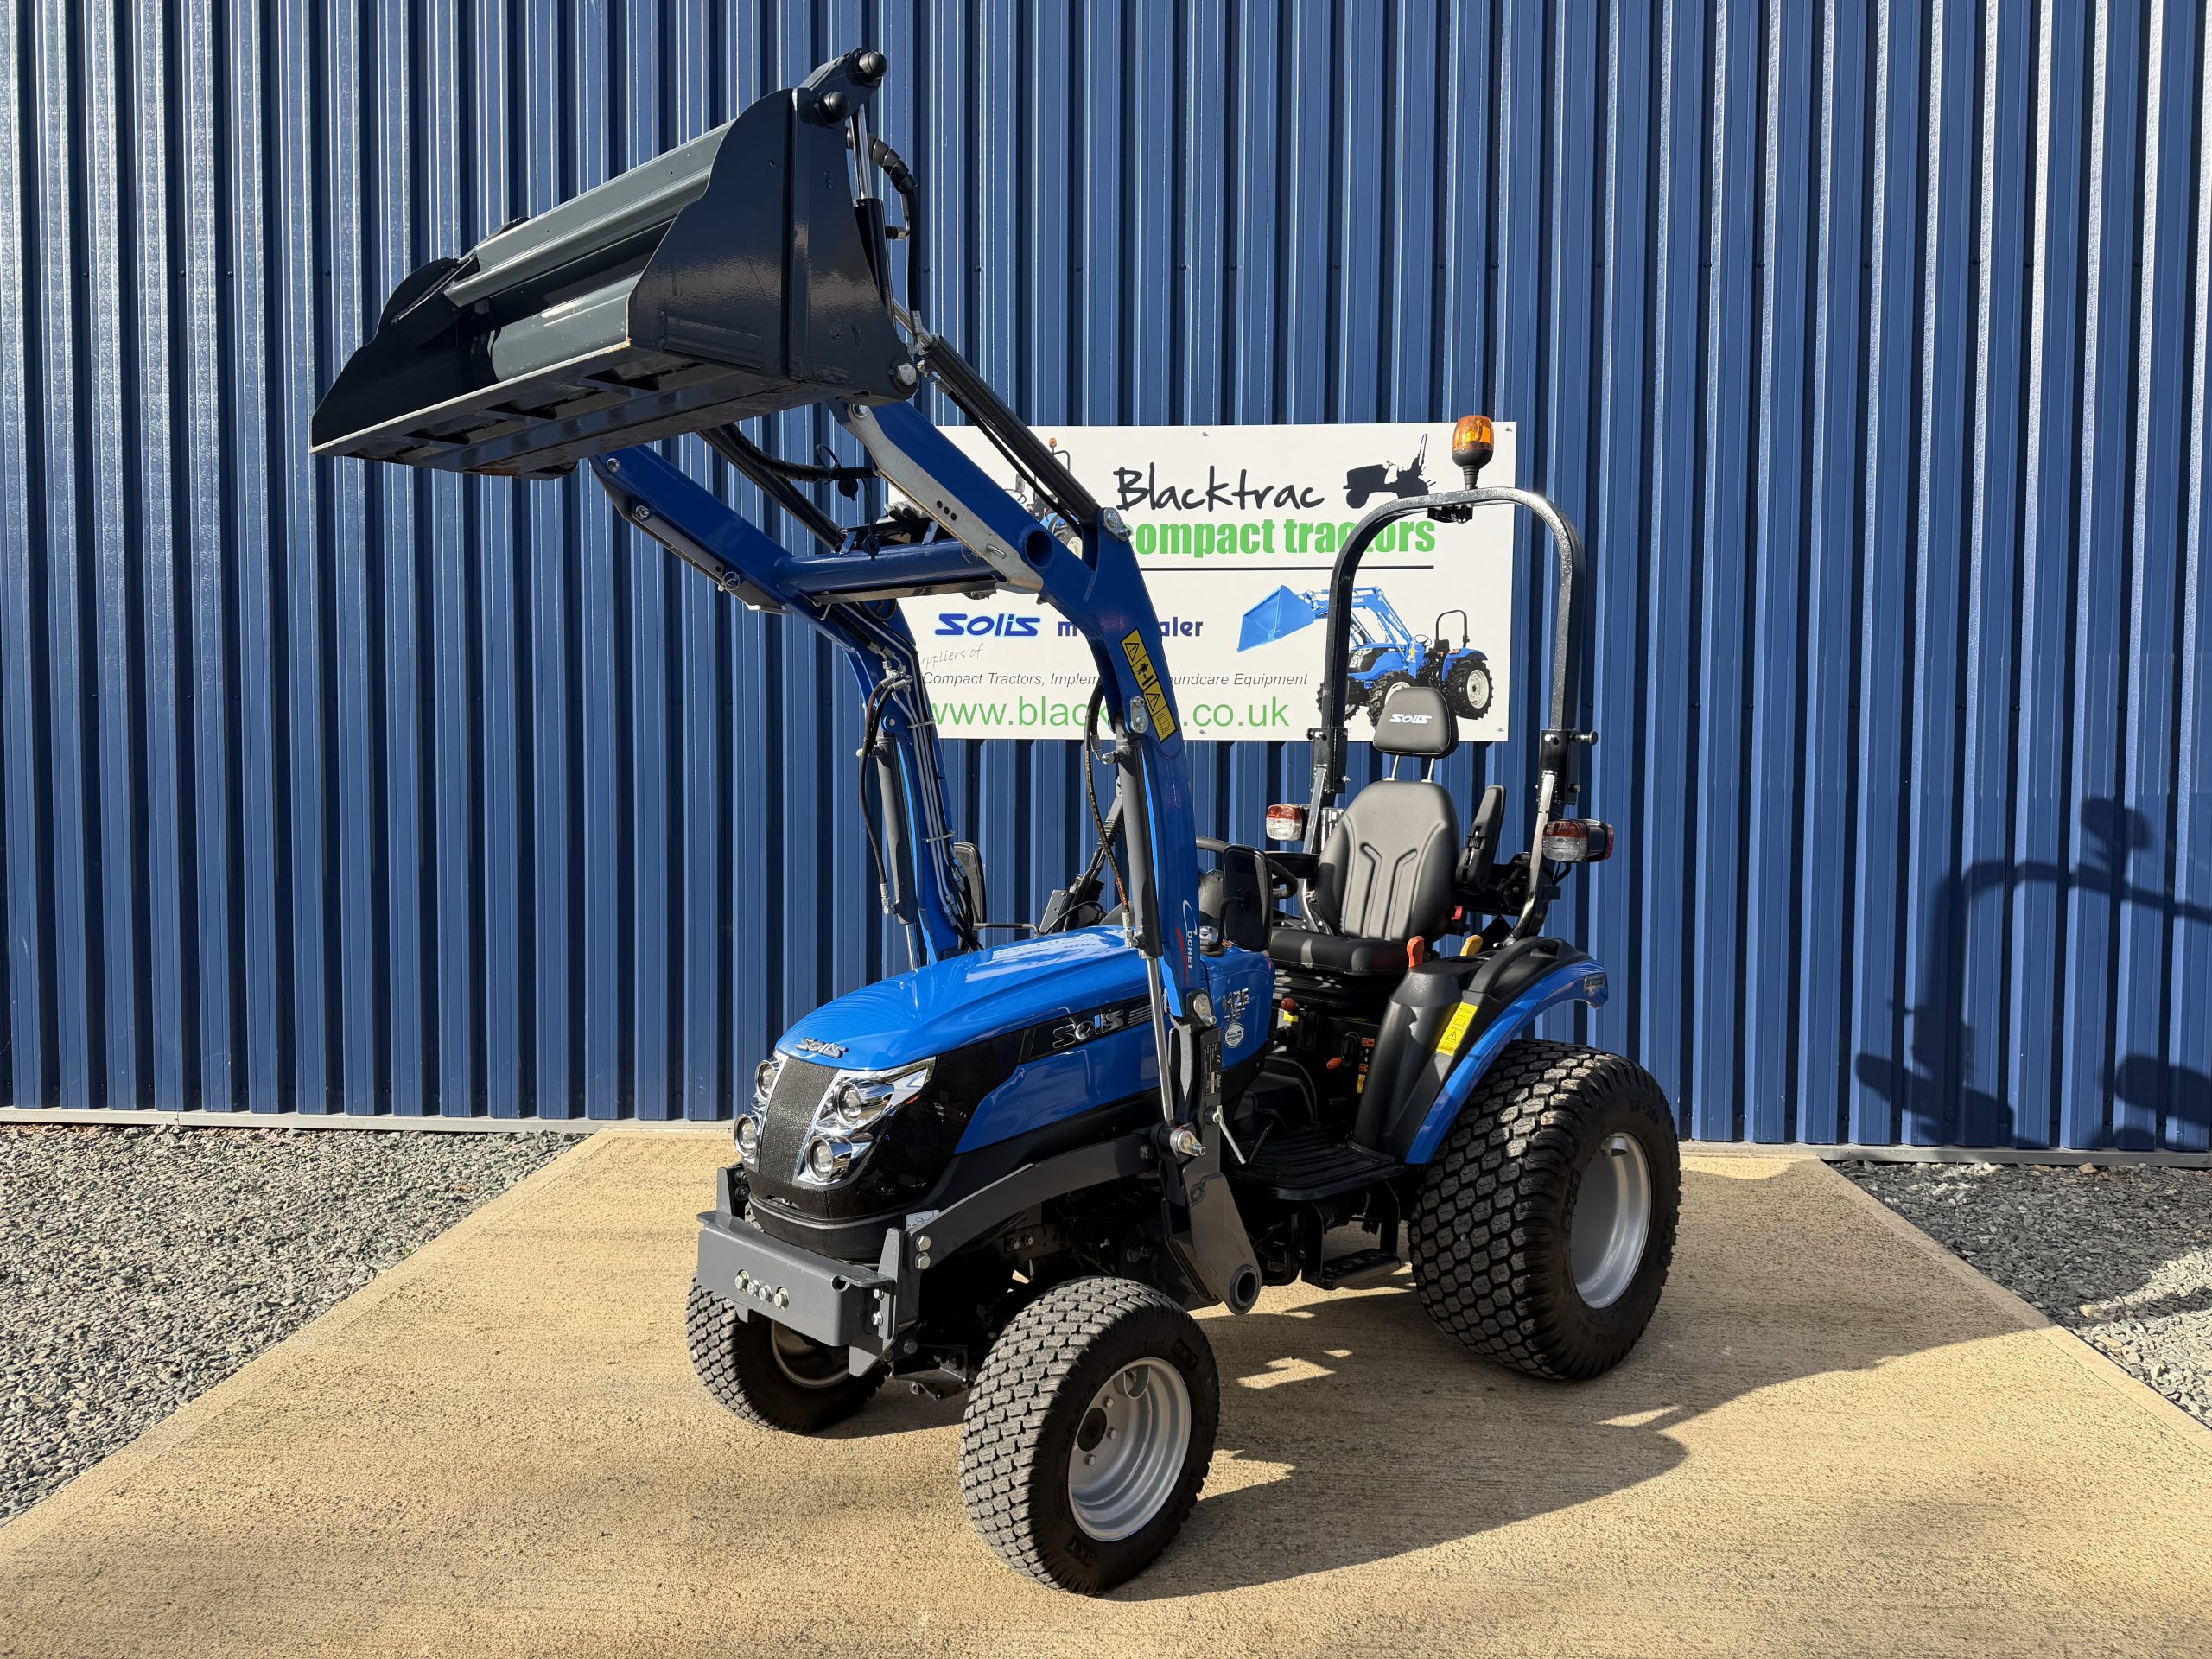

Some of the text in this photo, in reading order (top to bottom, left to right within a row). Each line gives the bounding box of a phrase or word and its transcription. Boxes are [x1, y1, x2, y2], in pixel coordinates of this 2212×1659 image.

[1113, 461, 1325, 512] Blacktrac
[969, 643, 984, 660] of
[922, 671, 984, 688] Compact
[988, 672, 1046, 688] Tractors,
[1233, 673, 1309, 688] Equipment
[1182, 899, 1198, 971] COCHET
[1064, 1535, 1096, 1567] BKT
